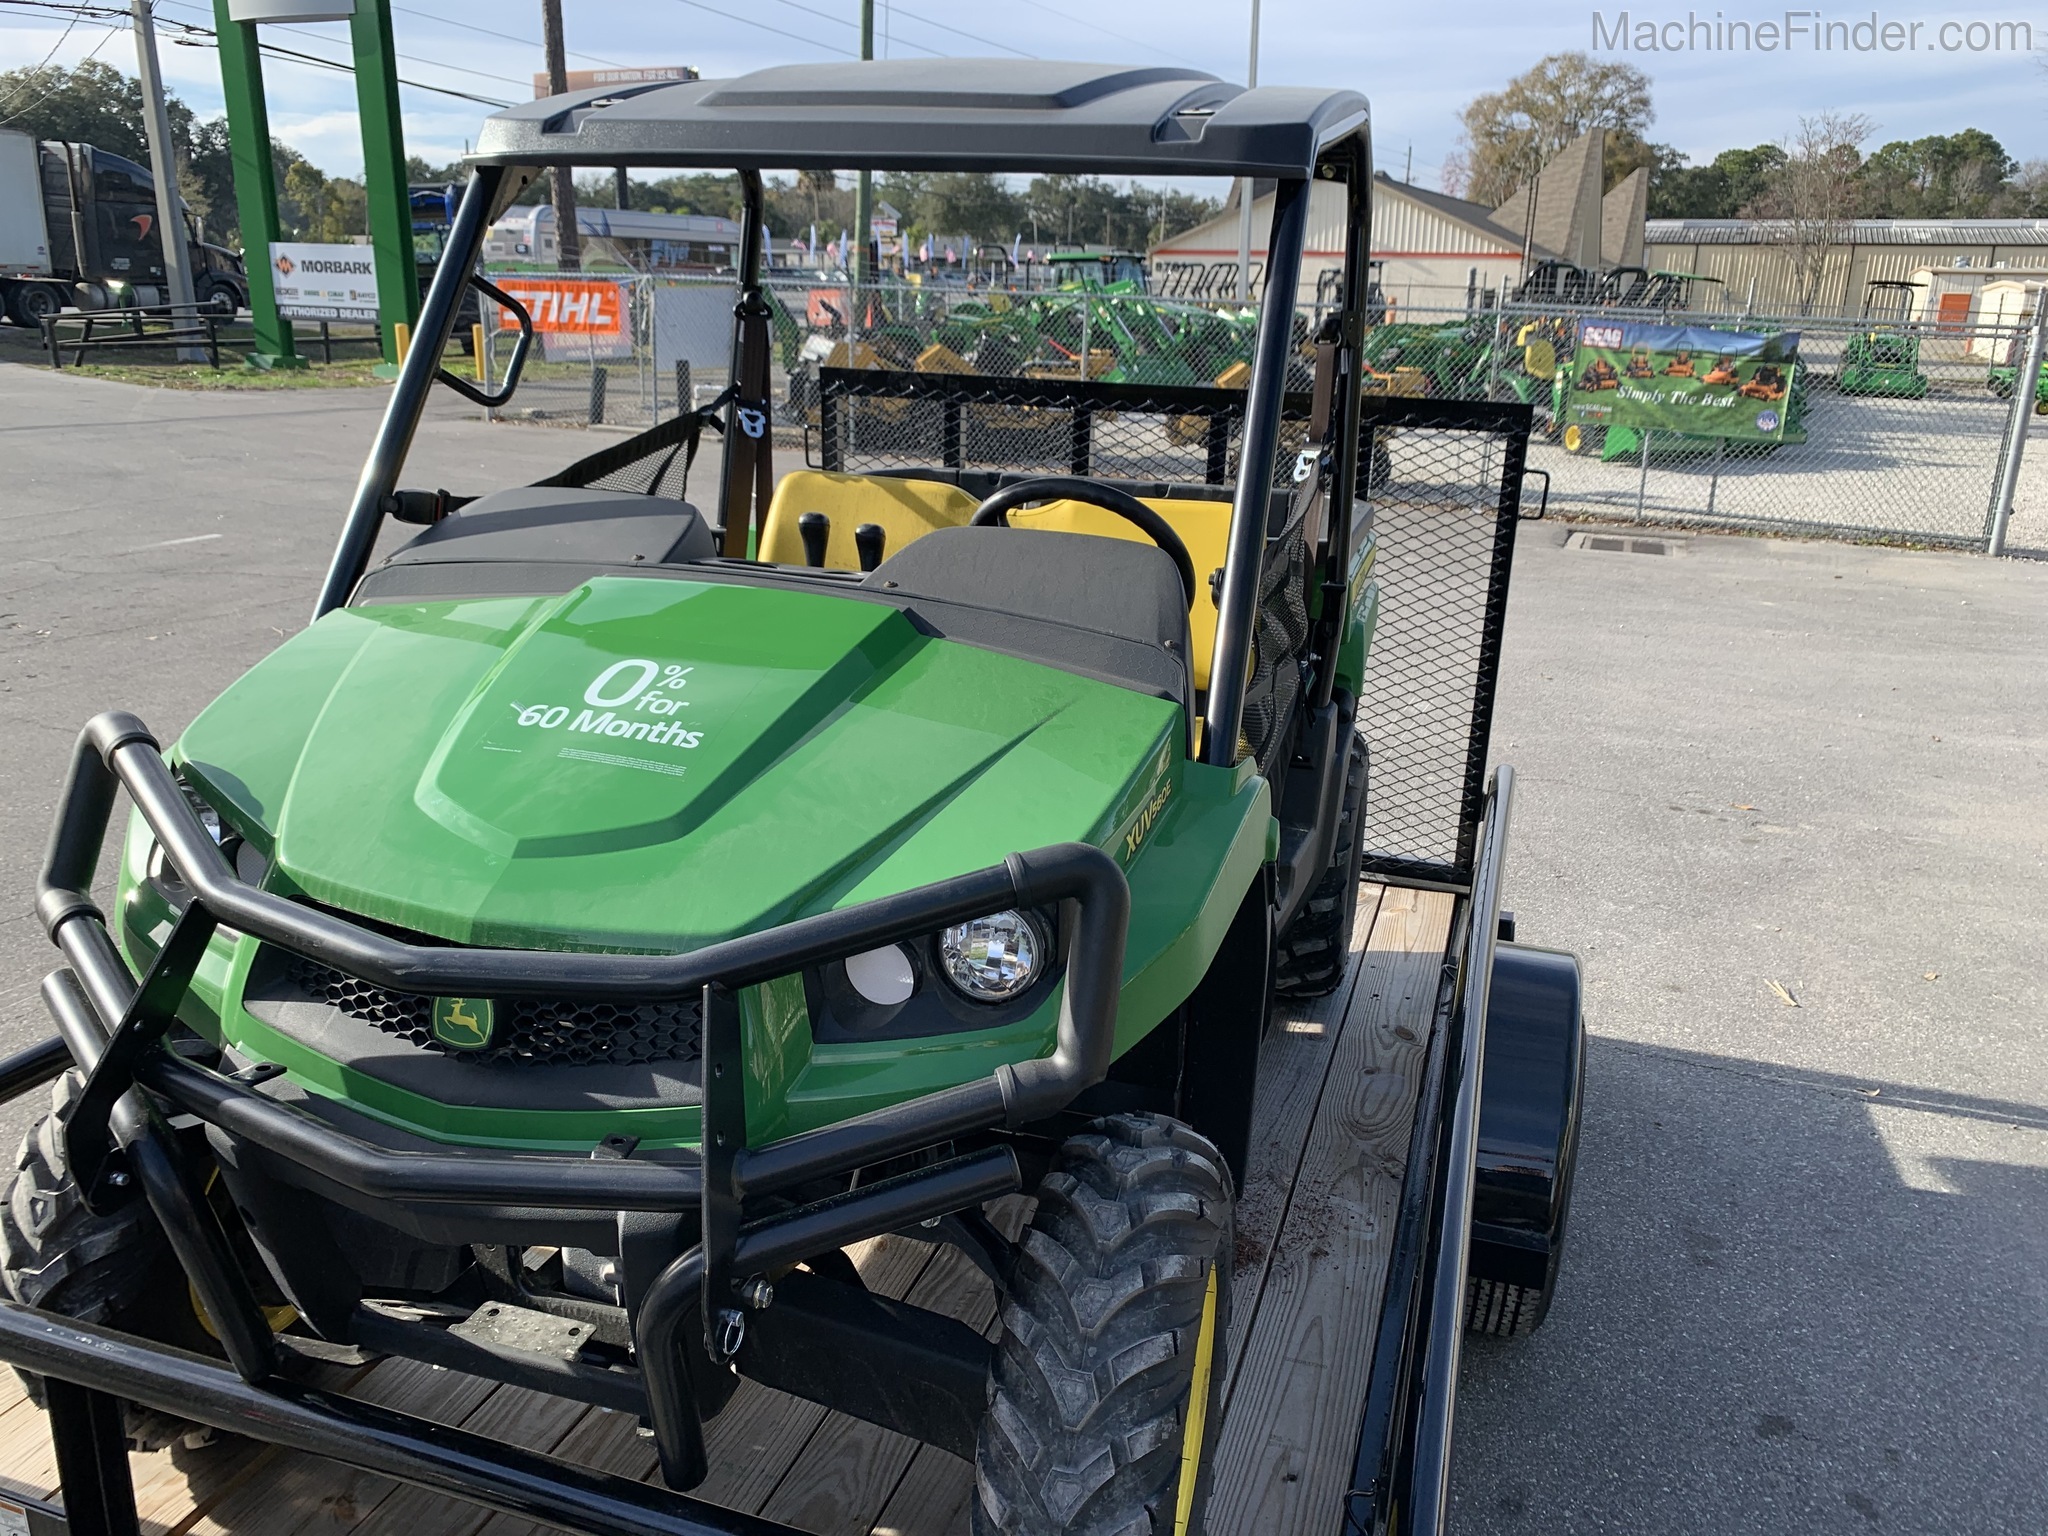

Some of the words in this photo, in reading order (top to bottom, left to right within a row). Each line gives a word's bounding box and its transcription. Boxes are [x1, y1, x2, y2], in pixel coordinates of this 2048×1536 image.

[301, 260, 372, 275] MORBARK
[280, 306, 337, 317] AUTHORIZED
[340, 308, 377, 319] DEALER
[503, 290, 612, 325] STIHL
[1585, 326, 1622, 341] SCAG
[1616, 385, 1665, 405] Simply
[1670, 390, 1695, 405] The
[1701, 393, 1736, 407] Best.
[634, 690, 690, 716] for
[517, 704, 570, 728] 60
[568, 709, 705, 749] Months
